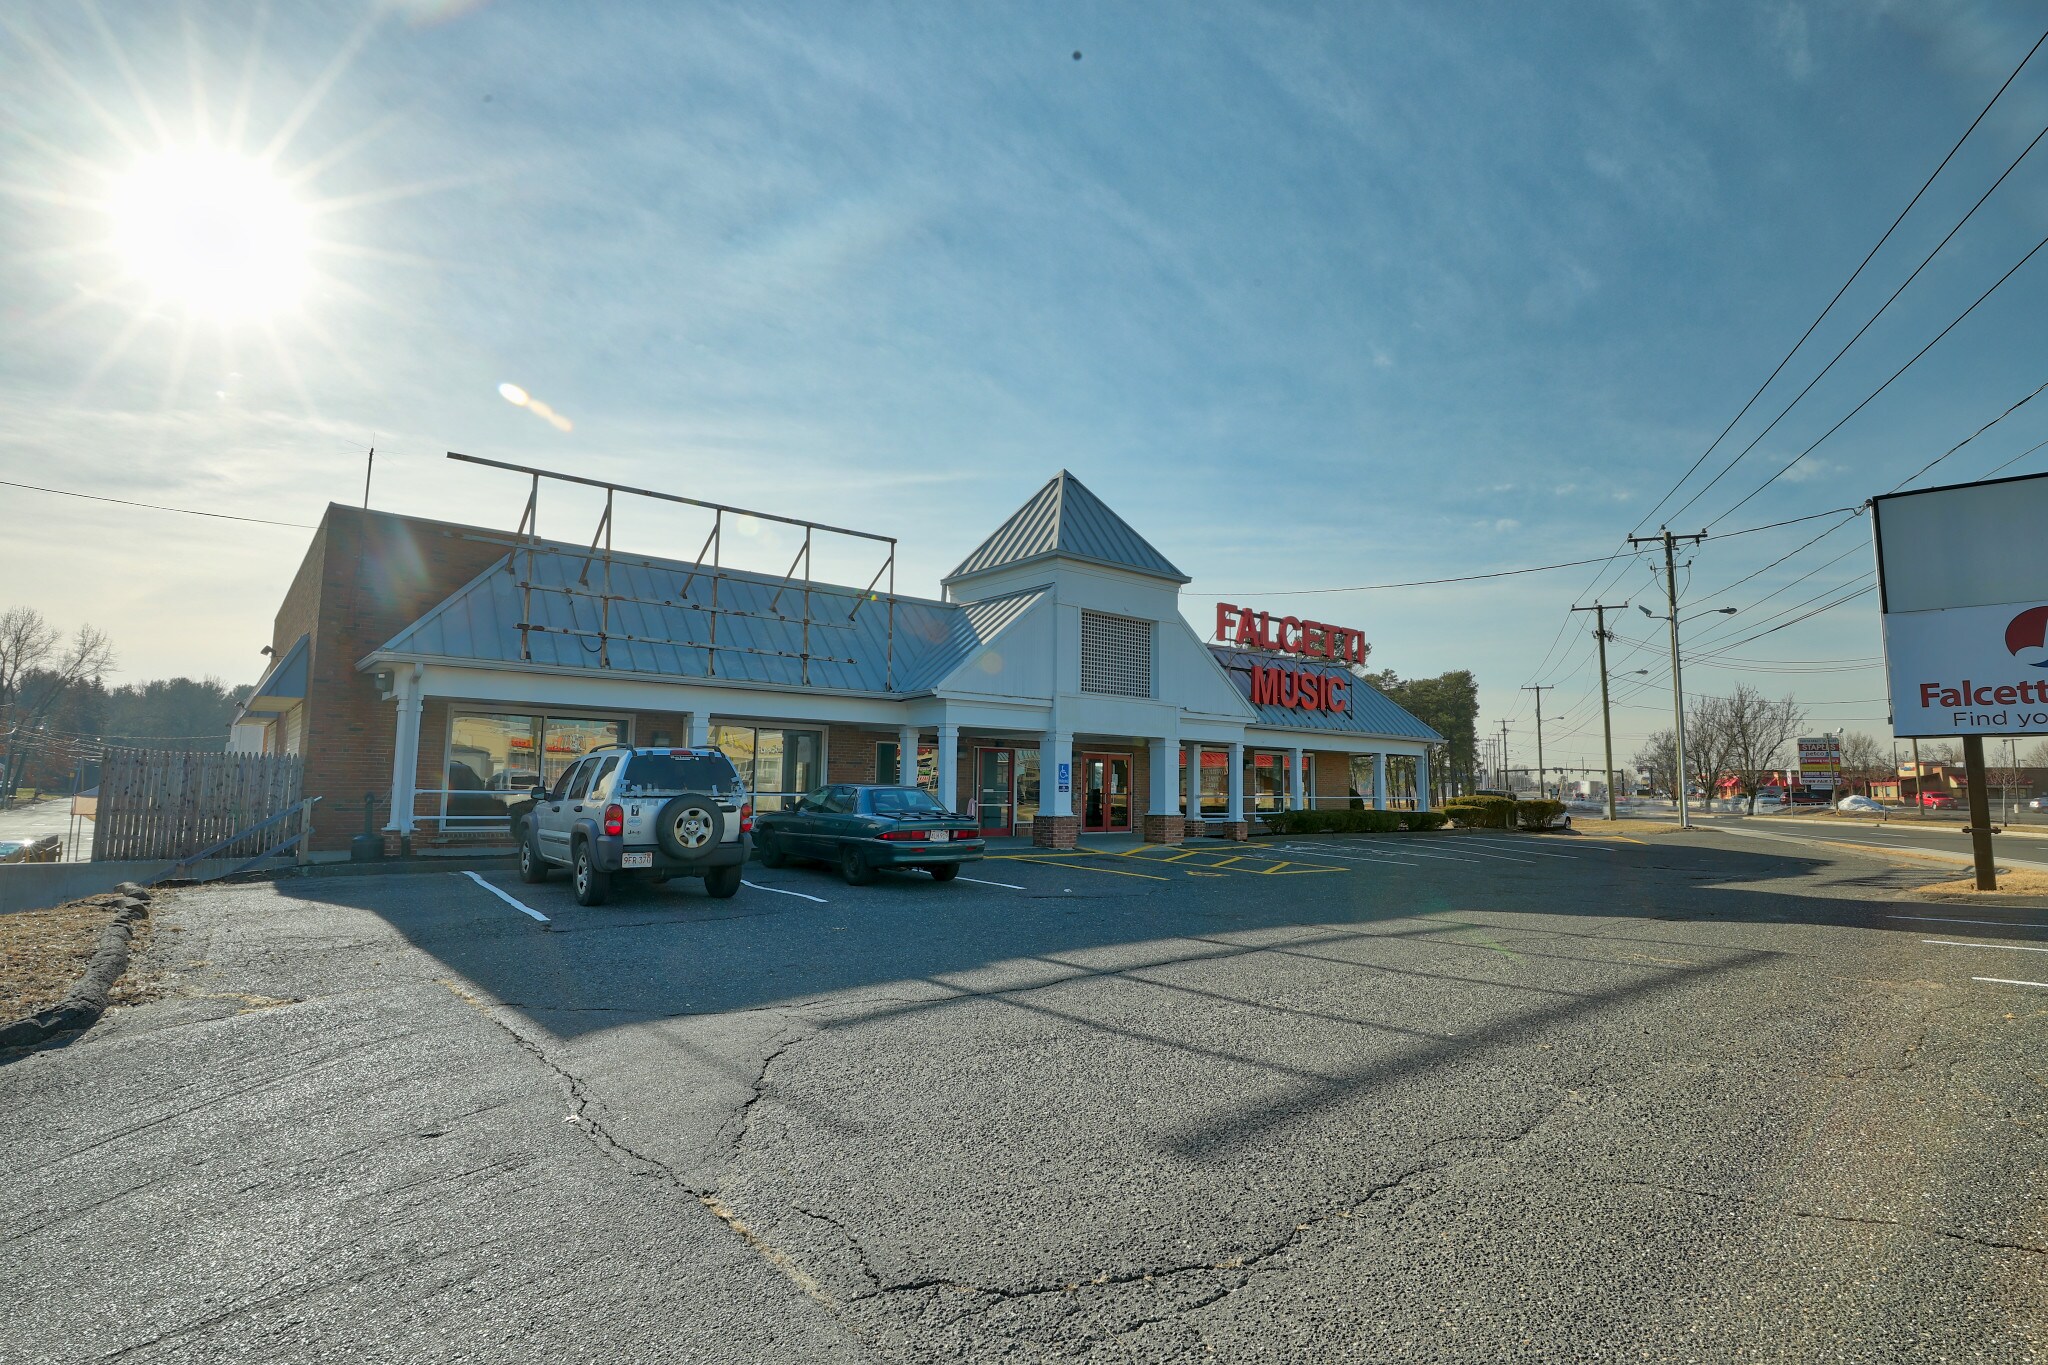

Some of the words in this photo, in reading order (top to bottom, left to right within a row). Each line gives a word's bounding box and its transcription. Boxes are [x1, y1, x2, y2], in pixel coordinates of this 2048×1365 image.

[1216, 602, 1365, 665] FALCETTI
[1251, 665, 1345, 713] MUSIC
[1919, 679, 2048, 708] Falcett
[1953, 710, 2007, 727] Find
[2017, 713, 2048, 728] yo
[623, 856, 637, 864] 9FR
